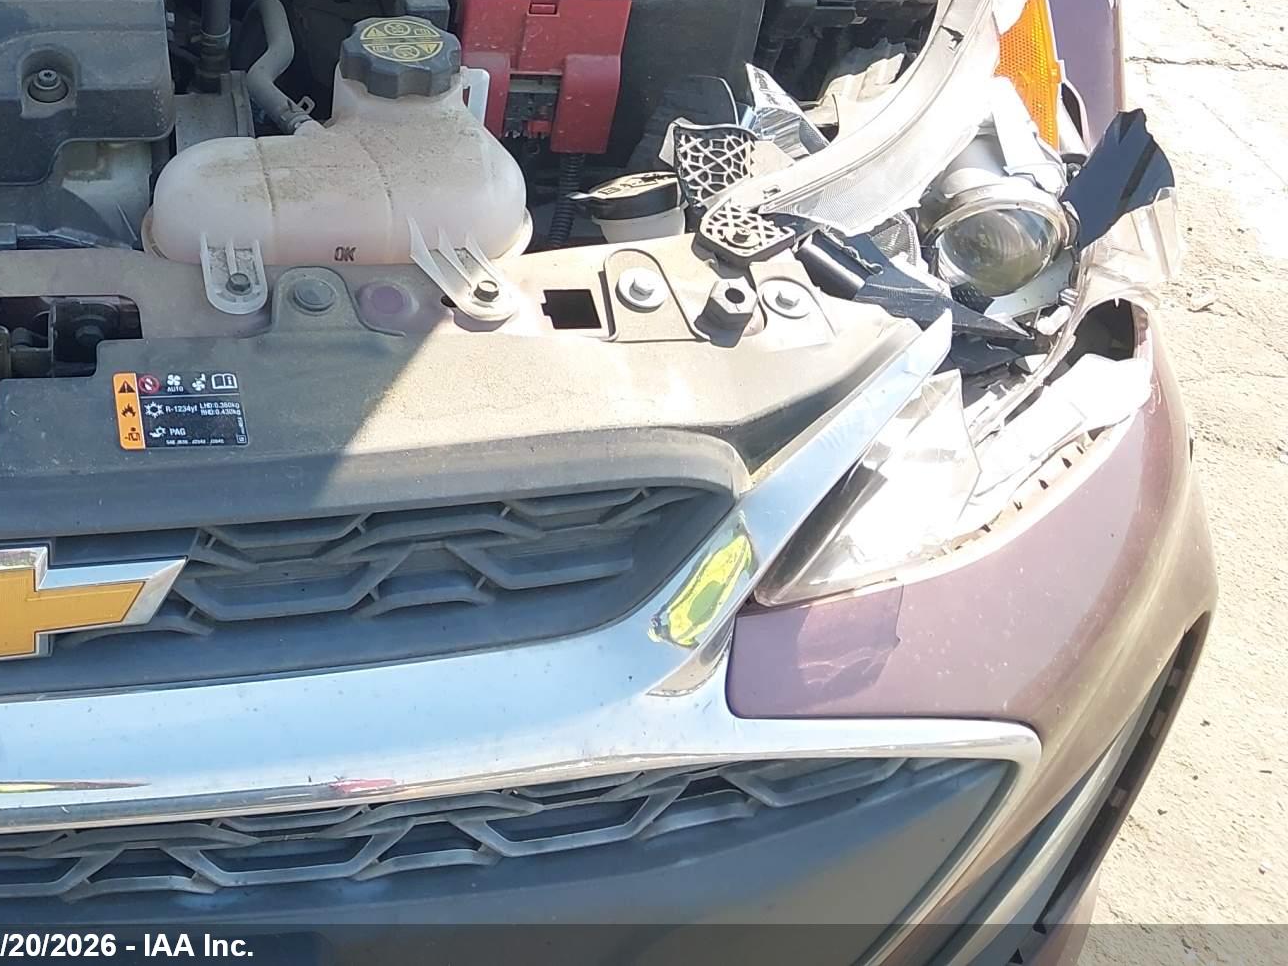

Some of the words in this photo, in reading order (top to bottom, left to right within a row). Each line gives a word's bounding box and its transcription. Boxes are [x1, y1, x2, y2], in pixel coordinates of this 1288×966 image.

[334, 246, 356, 262] OK
[167, 385, 184, 393] AUTO
[168, 427, 186, 436] PAG
